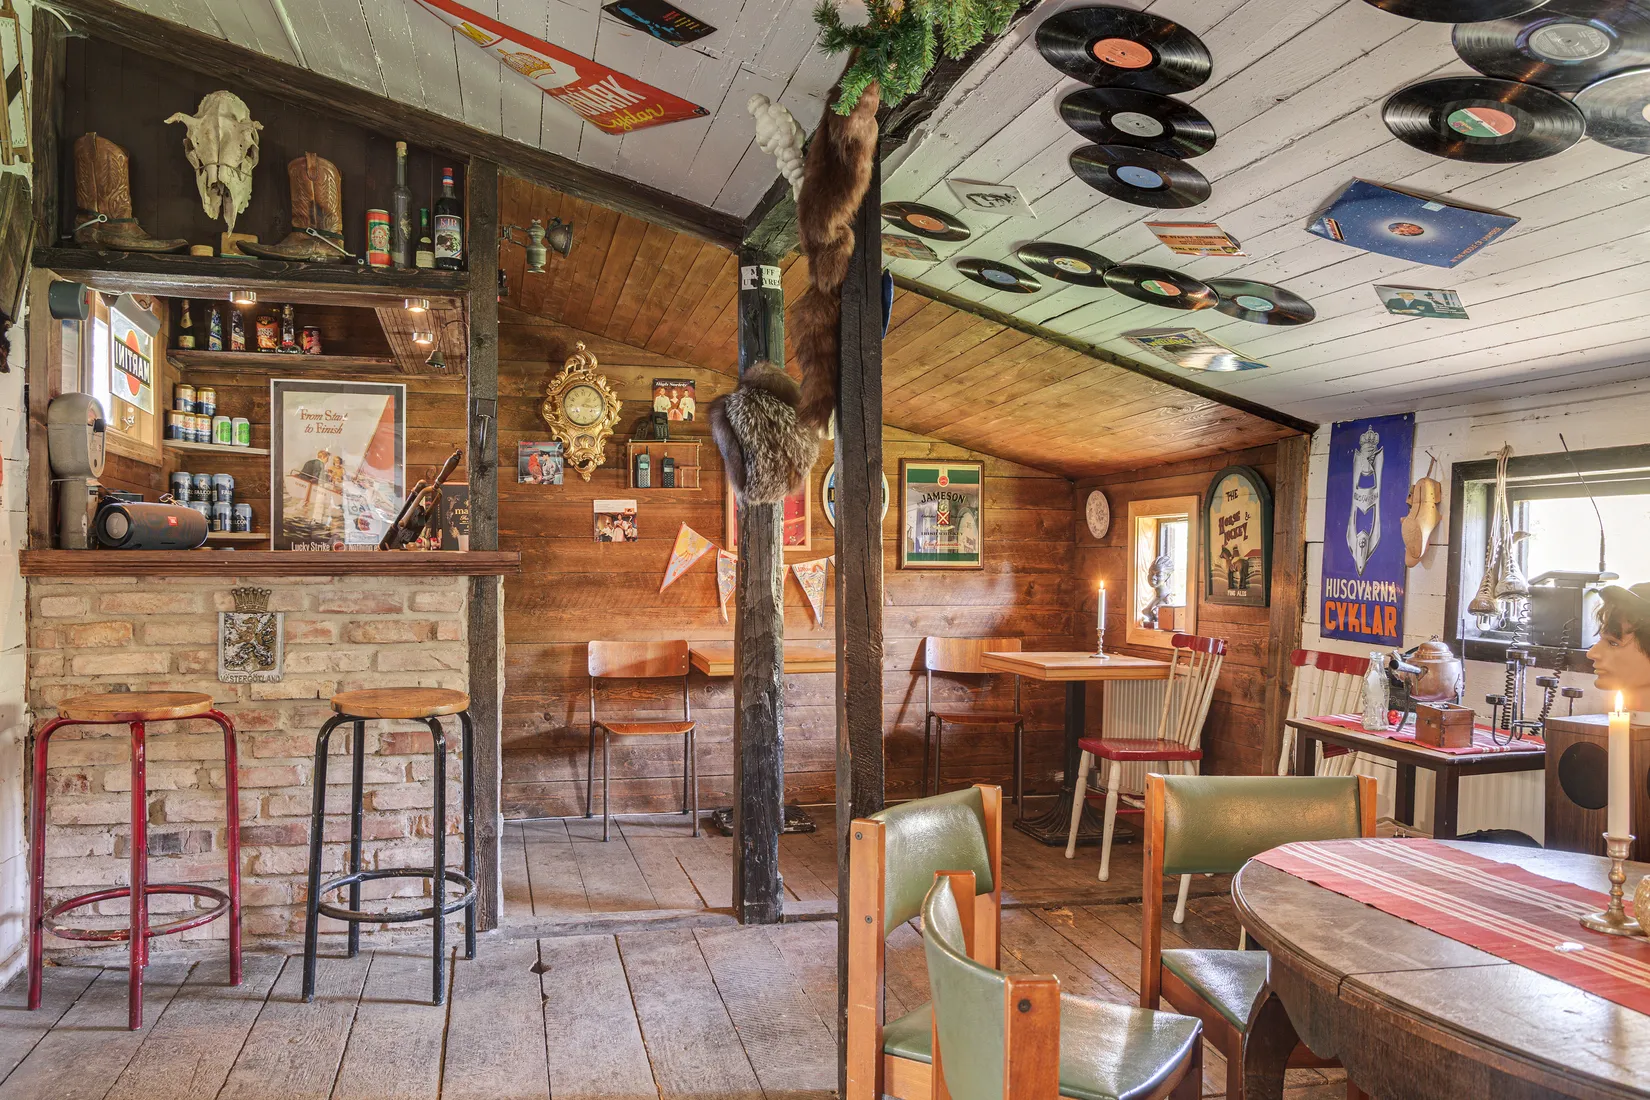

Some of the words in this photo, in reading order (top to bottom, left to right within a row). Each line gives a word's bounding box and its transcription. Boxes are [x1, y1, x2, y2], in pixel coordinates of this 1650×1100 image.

[553, 75, 647, 116] ONARK
[440, 217, 457, 228] KIR
[300, 409, 323, 421] From
[324, 410, 349, 422] Start
[304, 423, 314, 434] to
[315, 422, 344, 435] Finish
[921, 491, 966, 504] JAMESON
[1225, 489, 1239, 502] THE
[1244, 511, 1252, 521] &
[291, 542, 310, 551] Lucky
[310, 541, 331, 551] Strike
[1326, 578, 1398, 603] HUSQVARNA
[1325, 600, 1398, 638] CYKLAR
[220, 673, 281, 683] VÄSTERGÖTLAND
